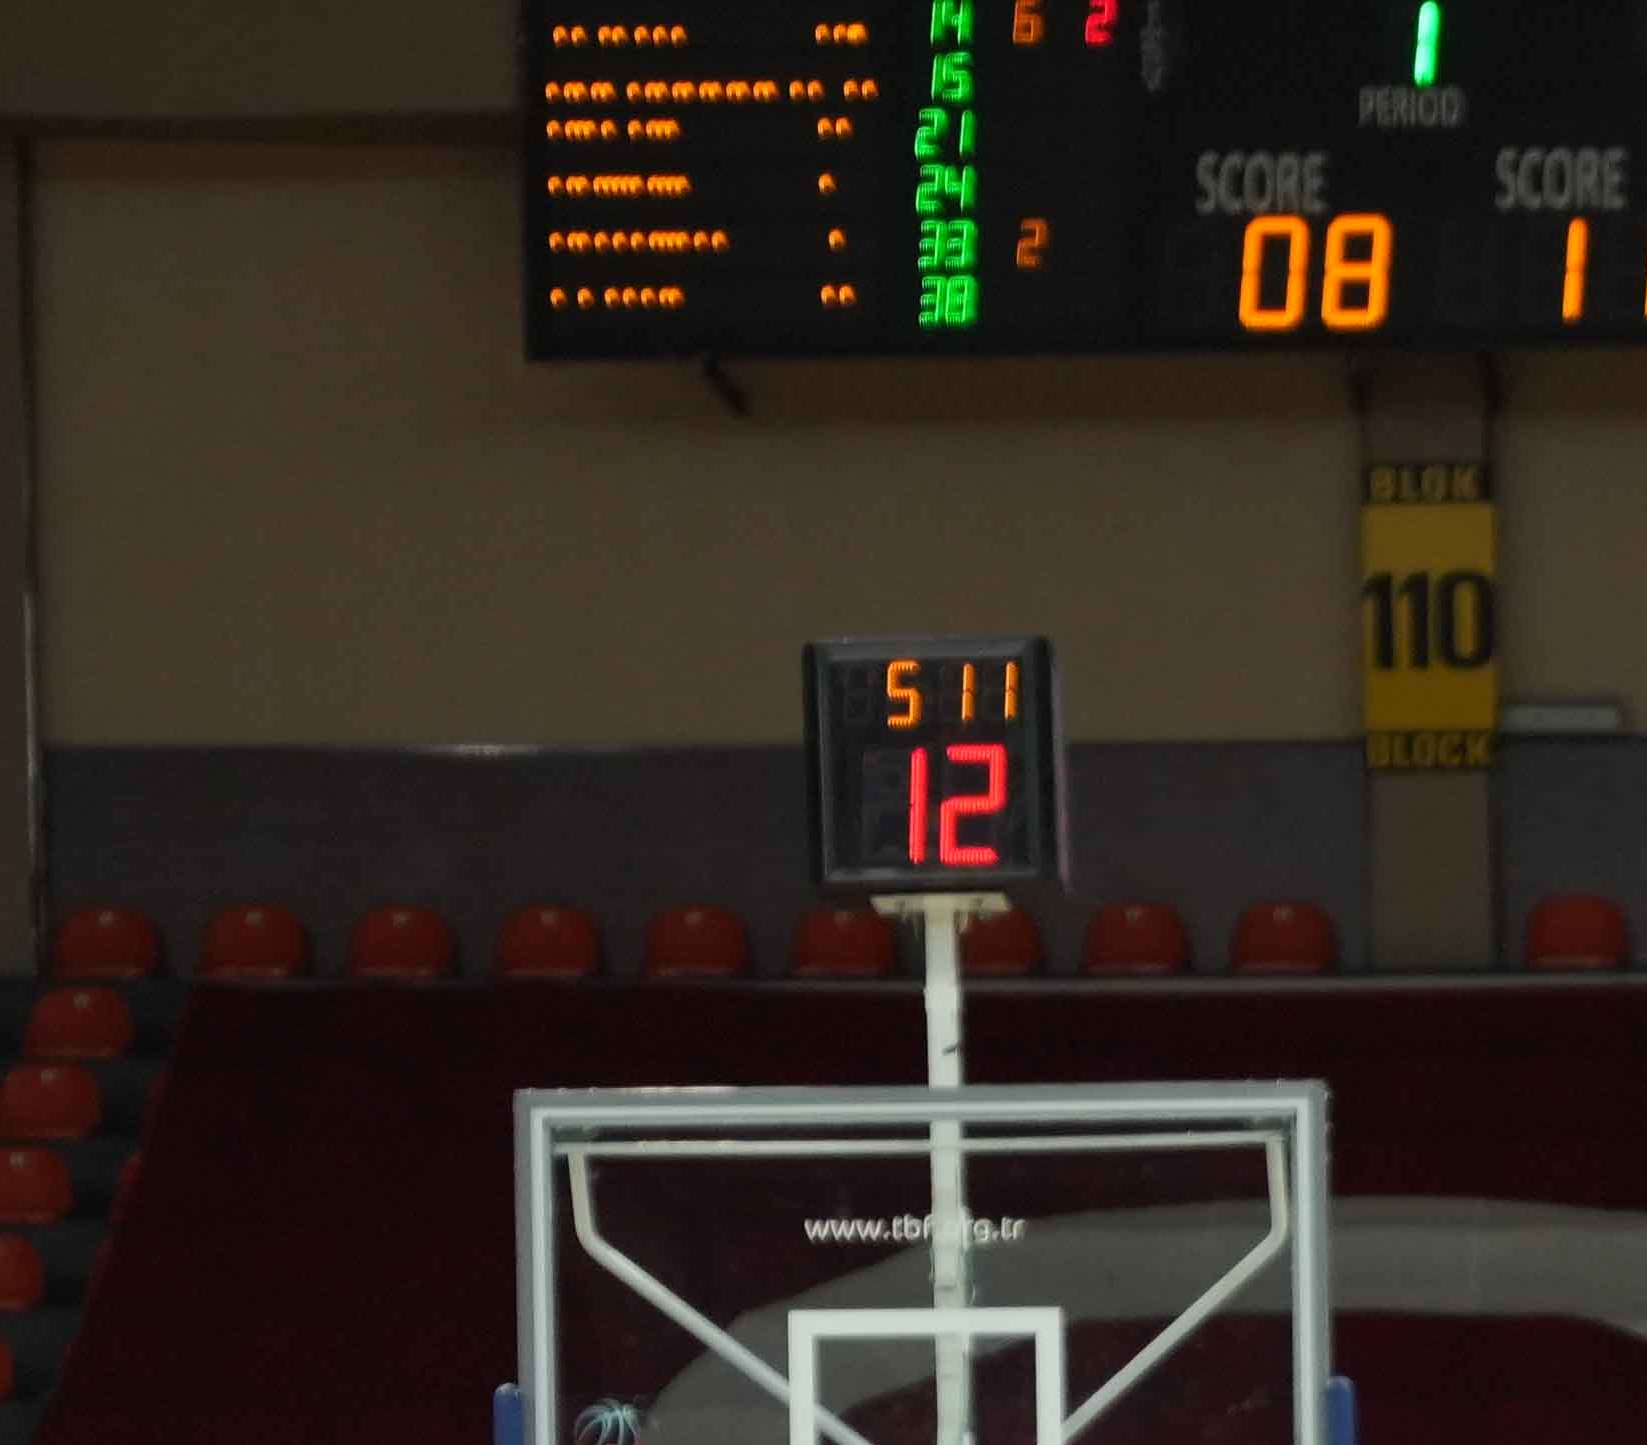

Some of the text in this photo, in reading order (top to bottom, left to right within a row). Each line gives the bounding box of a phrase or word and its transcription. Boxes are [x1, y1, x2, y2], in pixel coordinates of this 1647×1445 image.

[1085, 0, 1119, 46] 2
[1414, 0, 1440, 88] 1
[931, 51, 974, 101] 15
[914, 107, 975, 160] 21
[1358, 87, 1463, 127] PERIOD
[915, 163, 977, 215] 24
[1195, 151, 1328, 215] SCORE
[1494, 147, 1628, 210] SCORE
[917, 219, 977, 272] 33
[1016, 218, 1049, 269] 2
[1239, 213, 1393, 331] 08
[919, 275, 977, 329] 38
[1362, 571, 1494, 670] 110
[1365, 732, 1491, 767] BLOCK
[908, 743, 1009, 865] 12
[803, 1213, 1027, 1244] www.tbfg.tr
